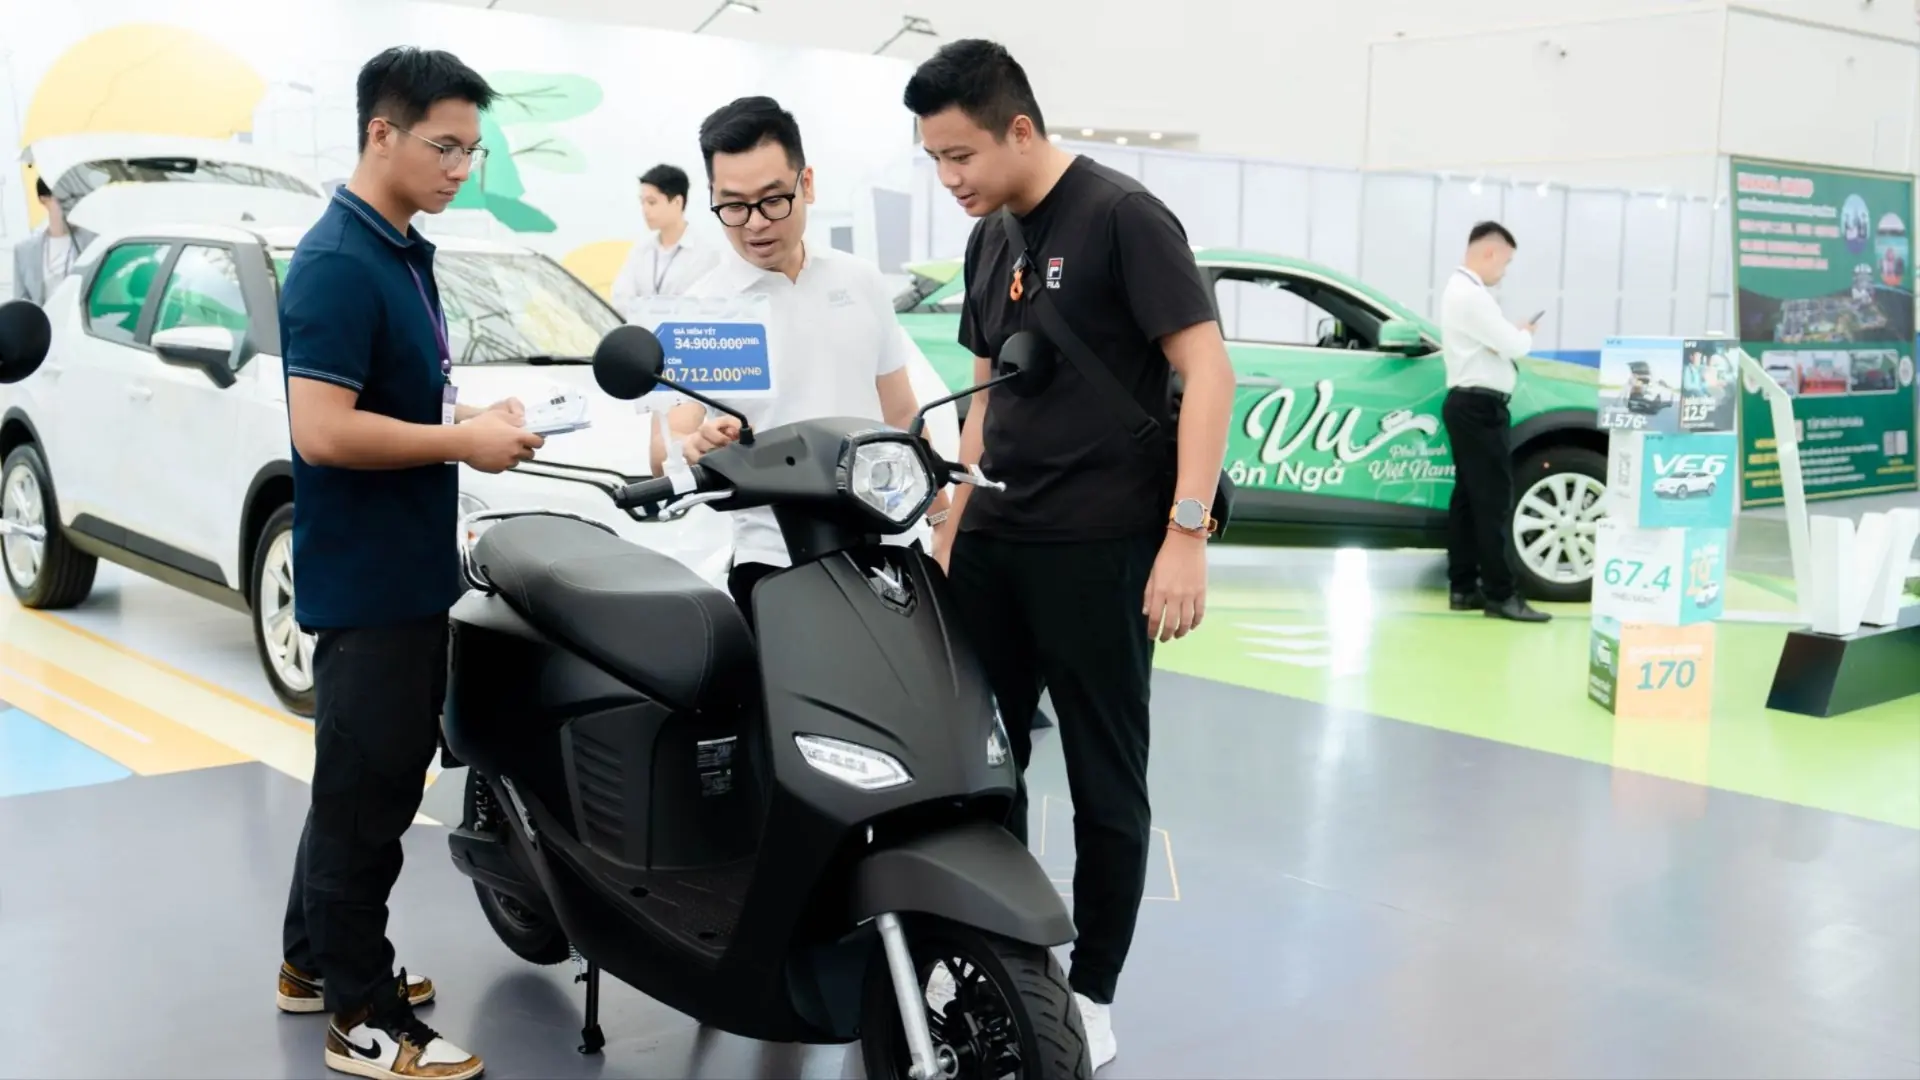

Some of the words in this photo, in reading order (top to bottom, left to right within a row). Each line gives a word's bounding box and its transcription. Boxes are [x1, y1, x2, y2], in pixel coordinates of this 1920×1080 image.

[1046, 280, 1061, 289] FILA
[1223, 460, 1267, 486] ôn
[1276, 459, 1346, 492] Ngả
[1603, 557, 1672, 593] 67.4
[1636, 659, 1696, 690] 170
